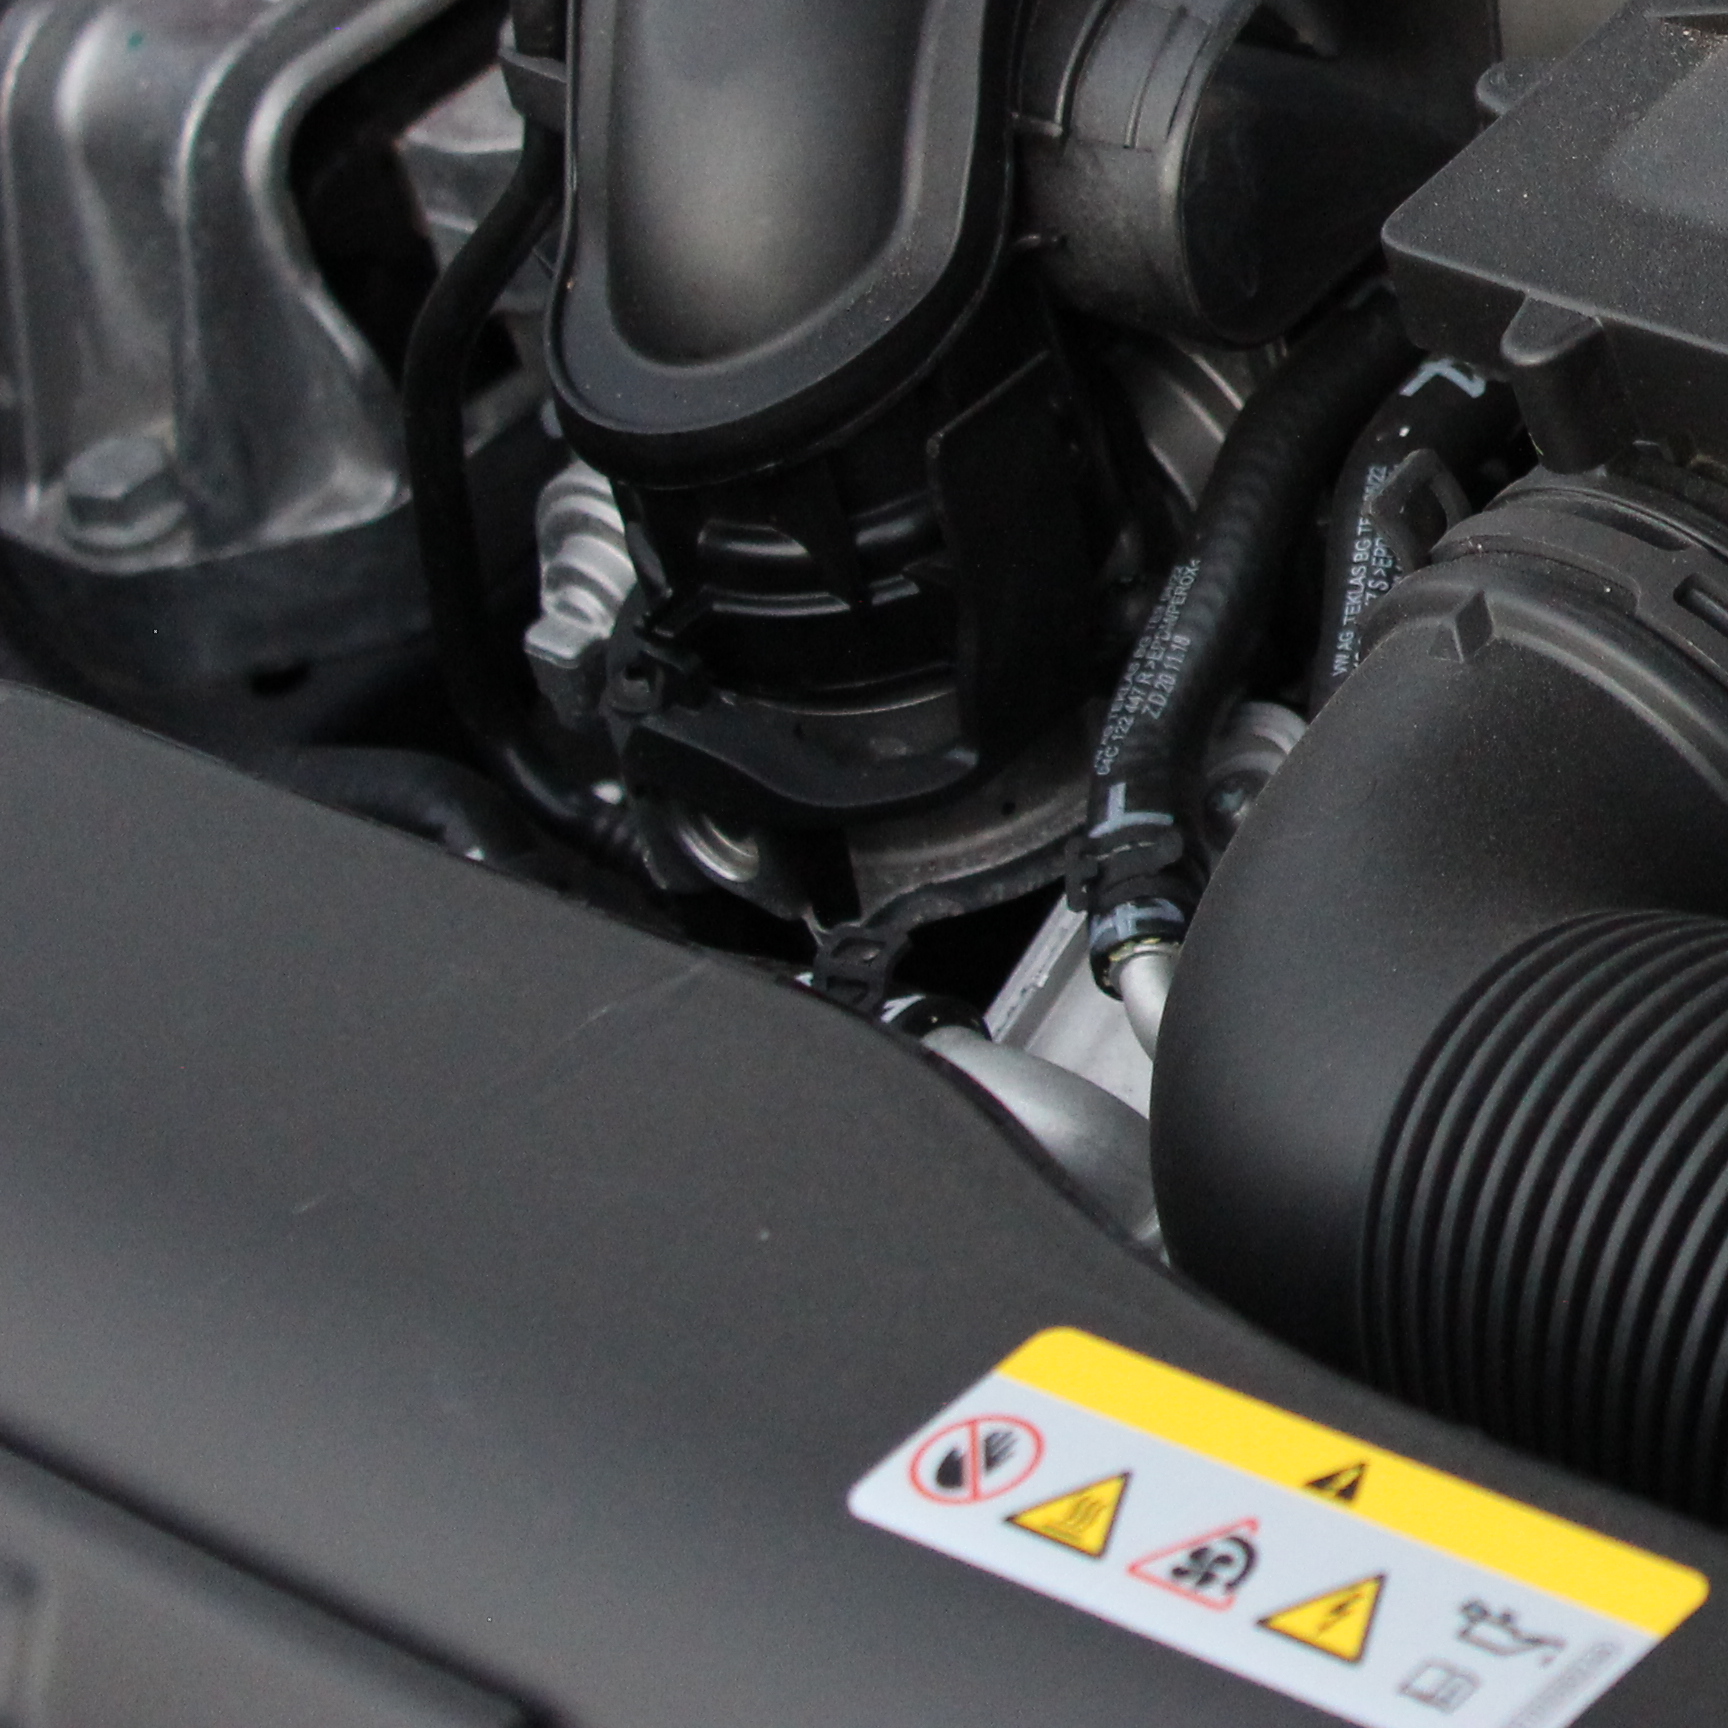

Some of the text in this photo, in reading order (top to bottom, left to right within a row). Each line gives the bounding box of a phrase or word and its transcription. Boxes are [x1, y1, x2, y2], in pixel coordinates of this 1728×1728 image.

[1353, 539, 1371, 563] BG
[1343, 565, 1367, 625] TEKLAS
[1337, 630, 1354, 651] AG
[1111, 715, 1135, 741] 122
